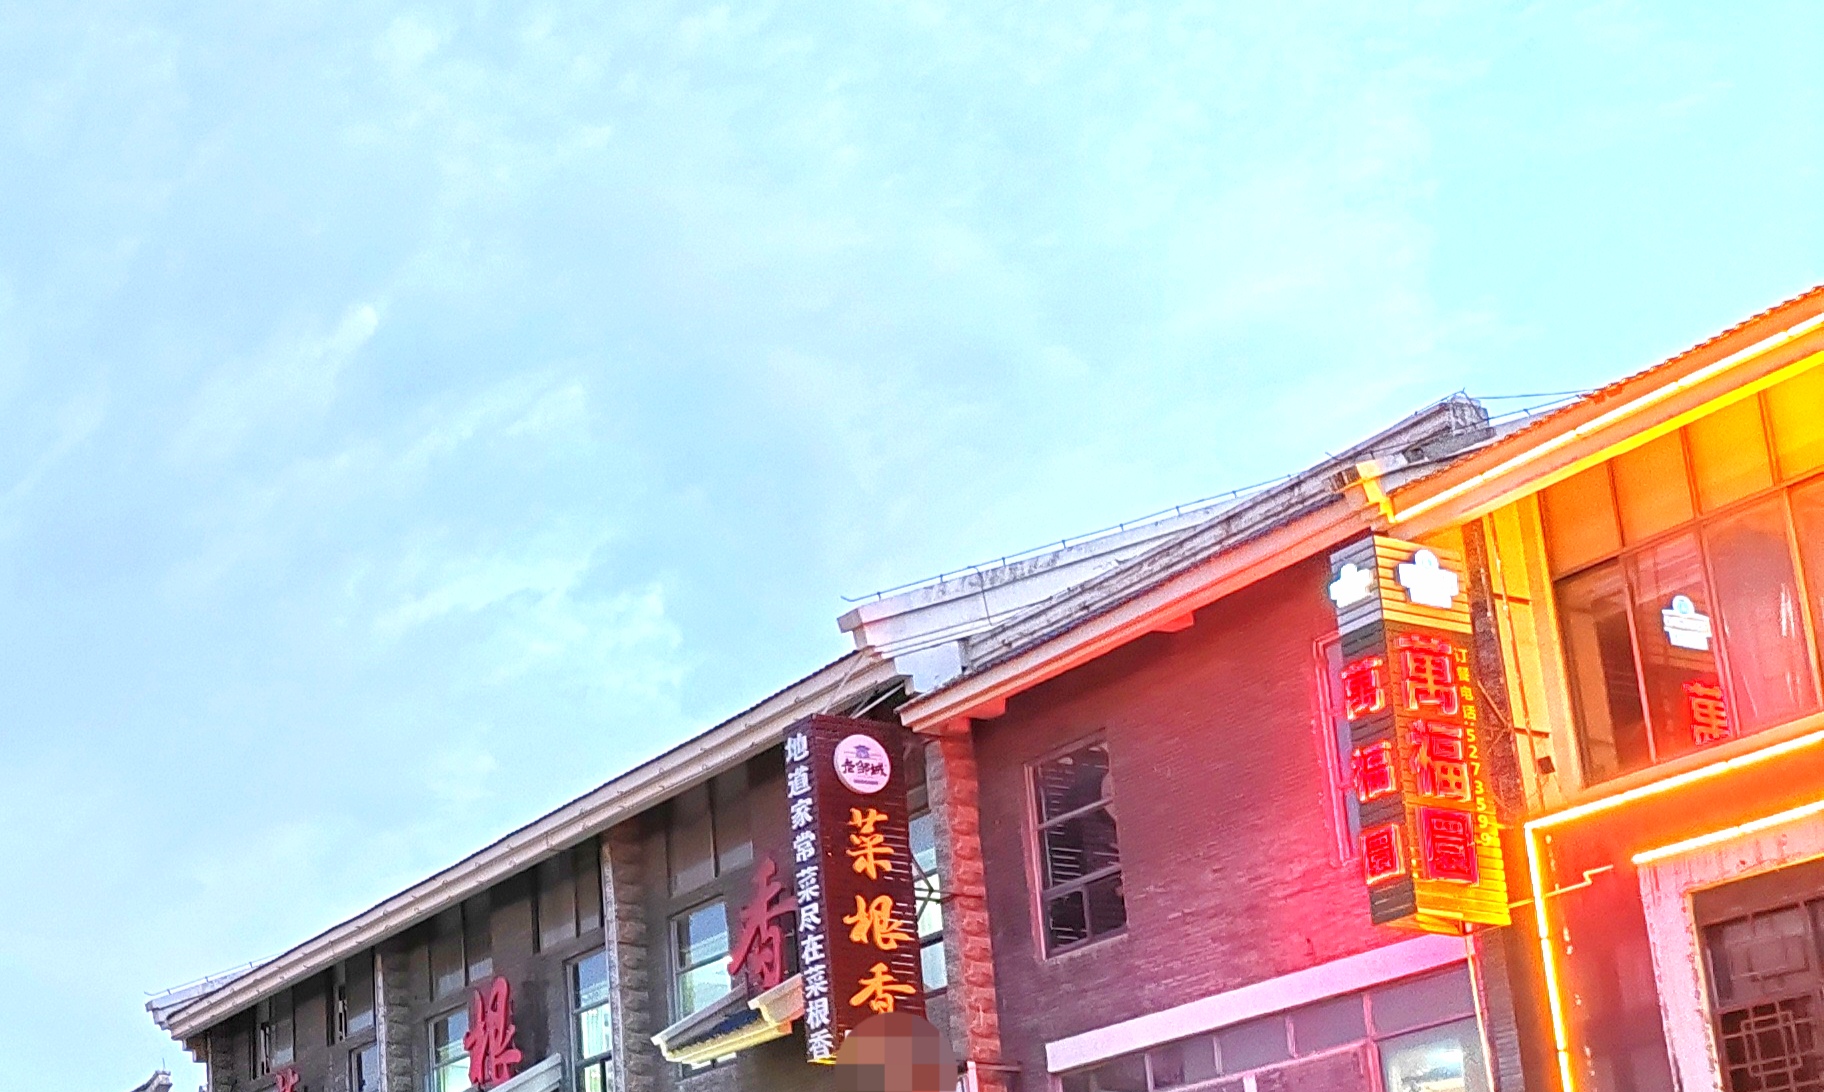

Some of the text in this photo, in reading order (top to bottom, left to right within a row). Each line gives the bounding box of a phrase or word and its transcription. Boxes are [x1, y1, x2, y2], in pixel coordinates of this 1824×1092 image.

[784, 732, 836, 1061] 地道家常菜尽在菜根香
[842, 807, 917, 1014] 菜根香
